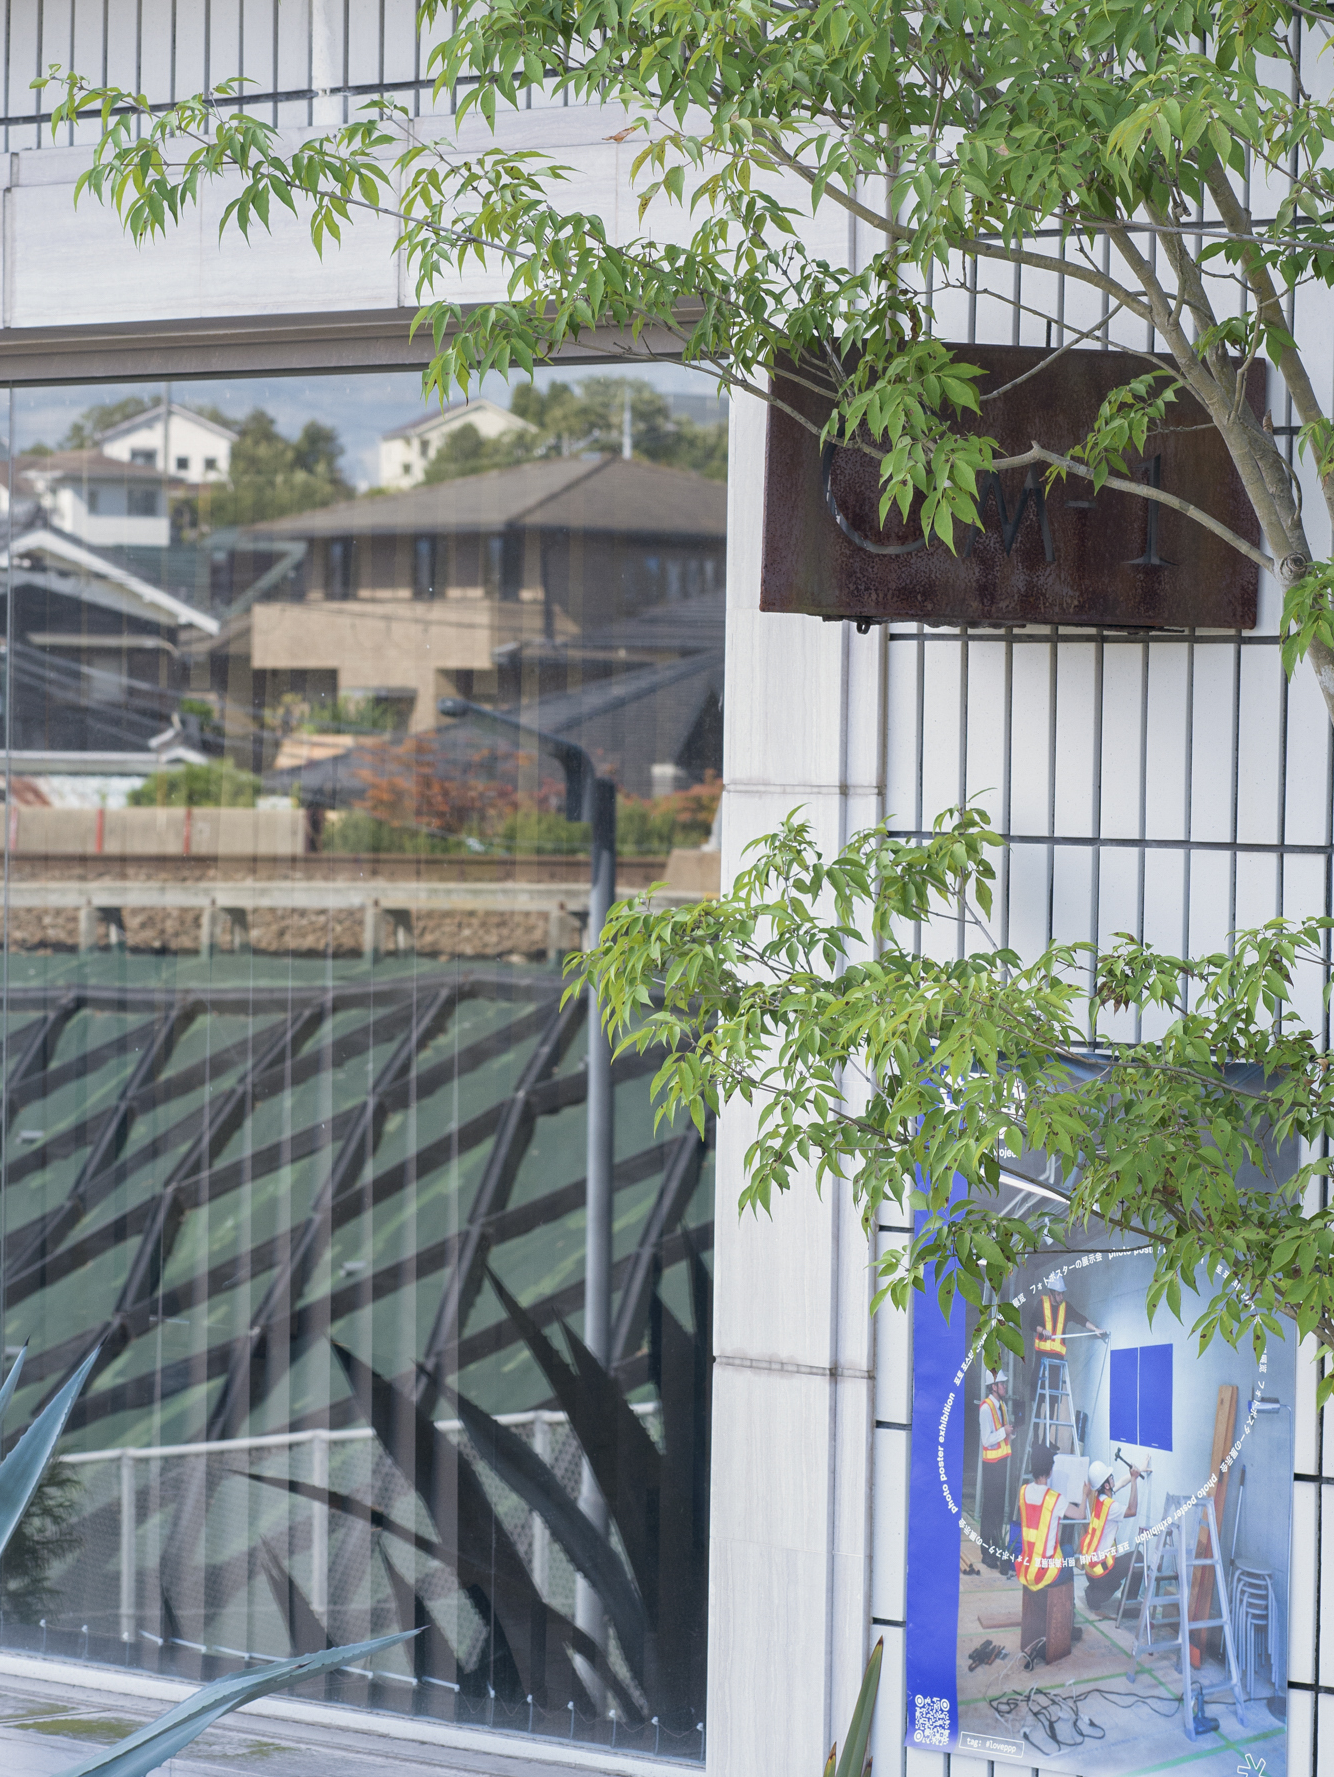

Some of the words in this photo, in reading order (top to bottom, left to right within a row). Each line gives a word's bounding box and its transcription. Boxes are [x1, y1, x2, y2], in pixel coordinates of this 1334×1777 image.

[1029, 1251, 1103, 1295] フォトポスターの展示会
[938, 1392, 956, 1443] exhibition
[1219, 1380, 1265, 1473] フォトポスターの展示会
[937, 1445, 948, 1481] poster
[941, 1483, 958, 1514] photo
[1197, 1473, 1219, 1497] photo
[1172, 1494, 1198, 1519] poster
[1135, 1516, 1173, 1545] exhibition
[967, 1737, 982, 1749] tag:
[985, 1740, 1017, 1754] #loveppp
